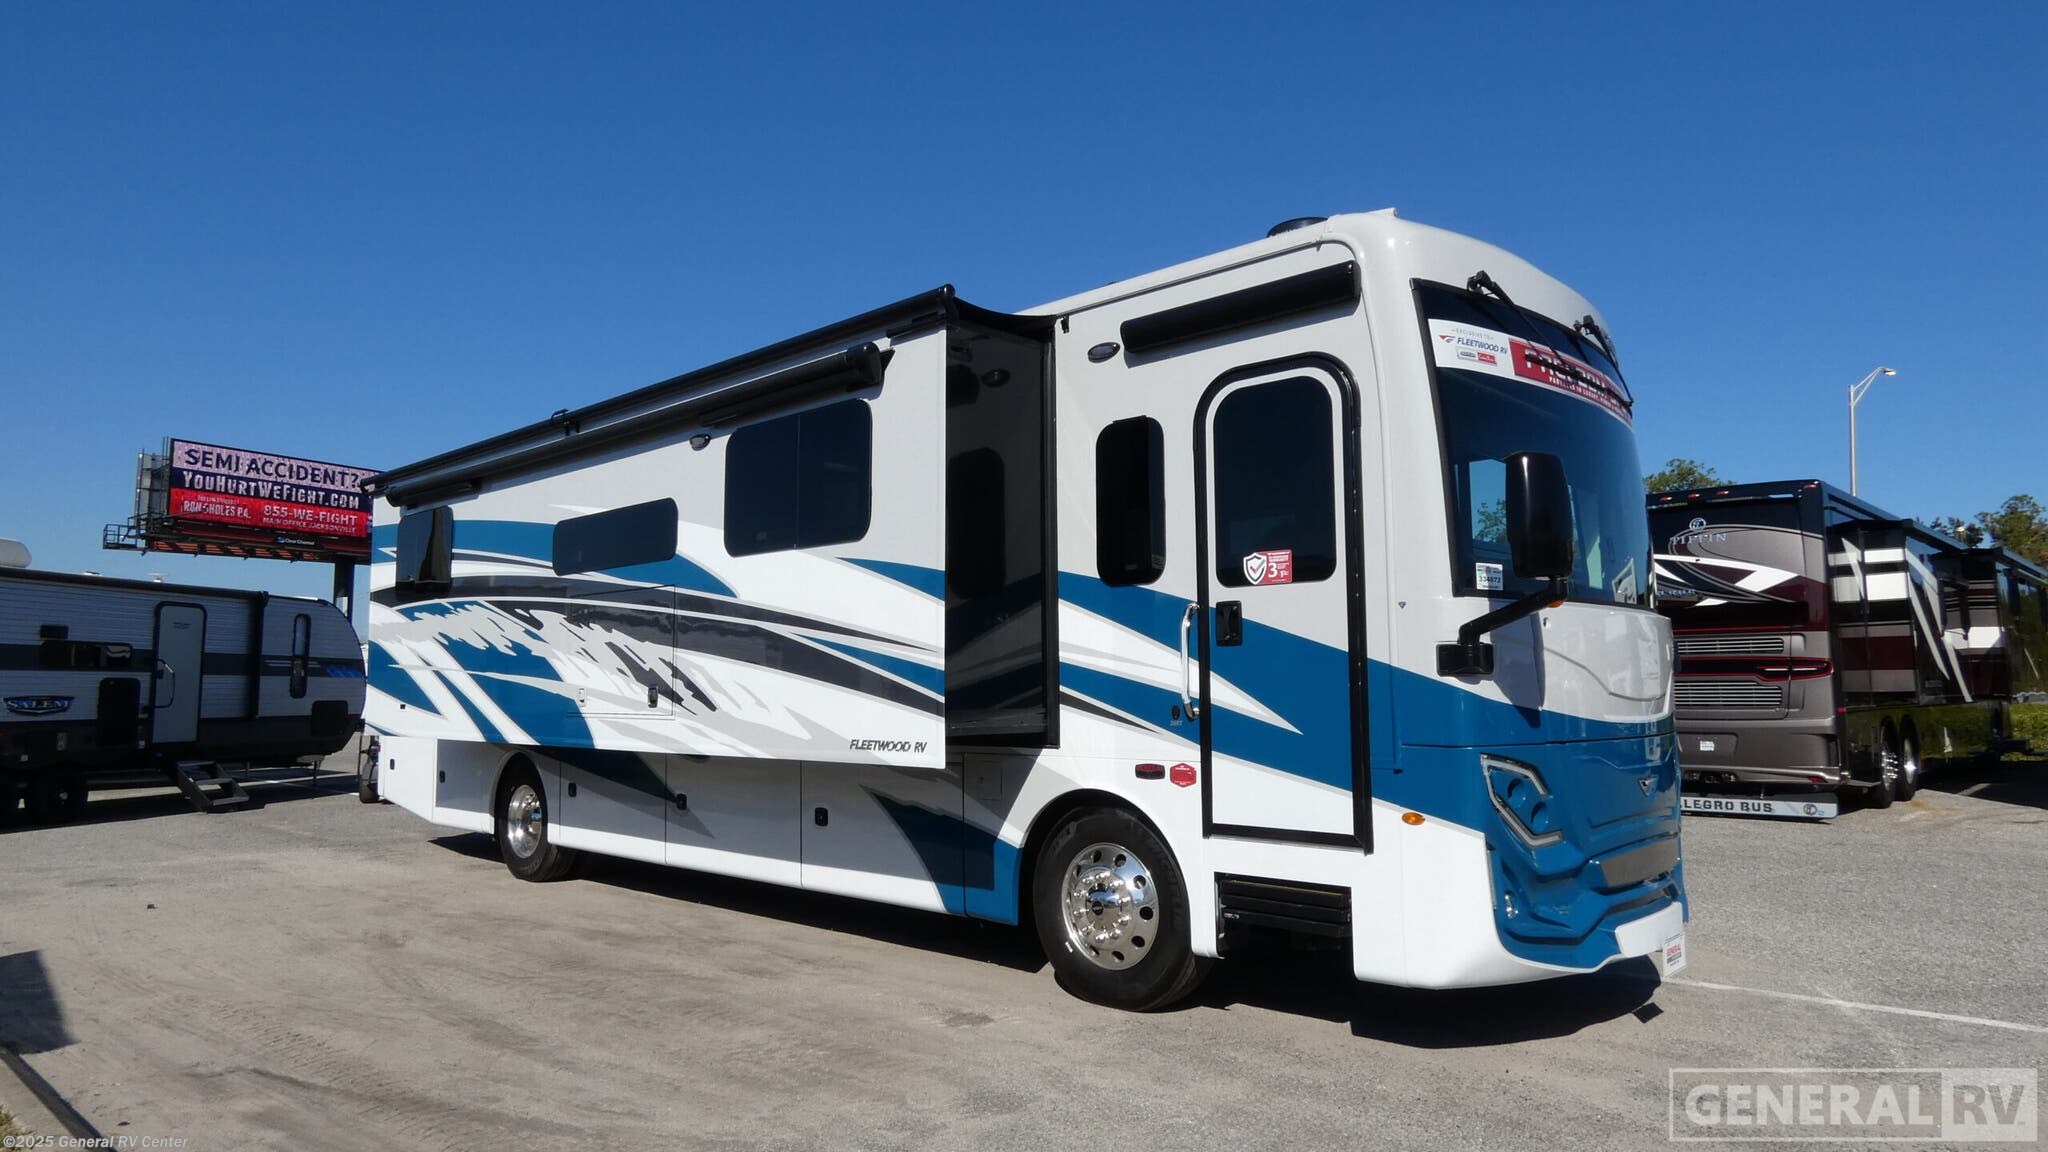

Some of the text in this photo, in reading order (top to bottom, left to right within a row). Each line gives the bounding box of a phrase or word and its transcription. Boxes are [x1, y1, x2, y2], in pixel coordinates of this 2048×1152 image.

[1457, 337, 1508, 354] FLEETWOOD RV
[185, 449, 359, 488] SEMI ACCIDENT?
[264, 505, 357, 525] 855-WE-FIGHT
[850, 739, 927, 753] FLEETWOOD RV
[1680, 799, 1773, 813] LEGRO BUS
